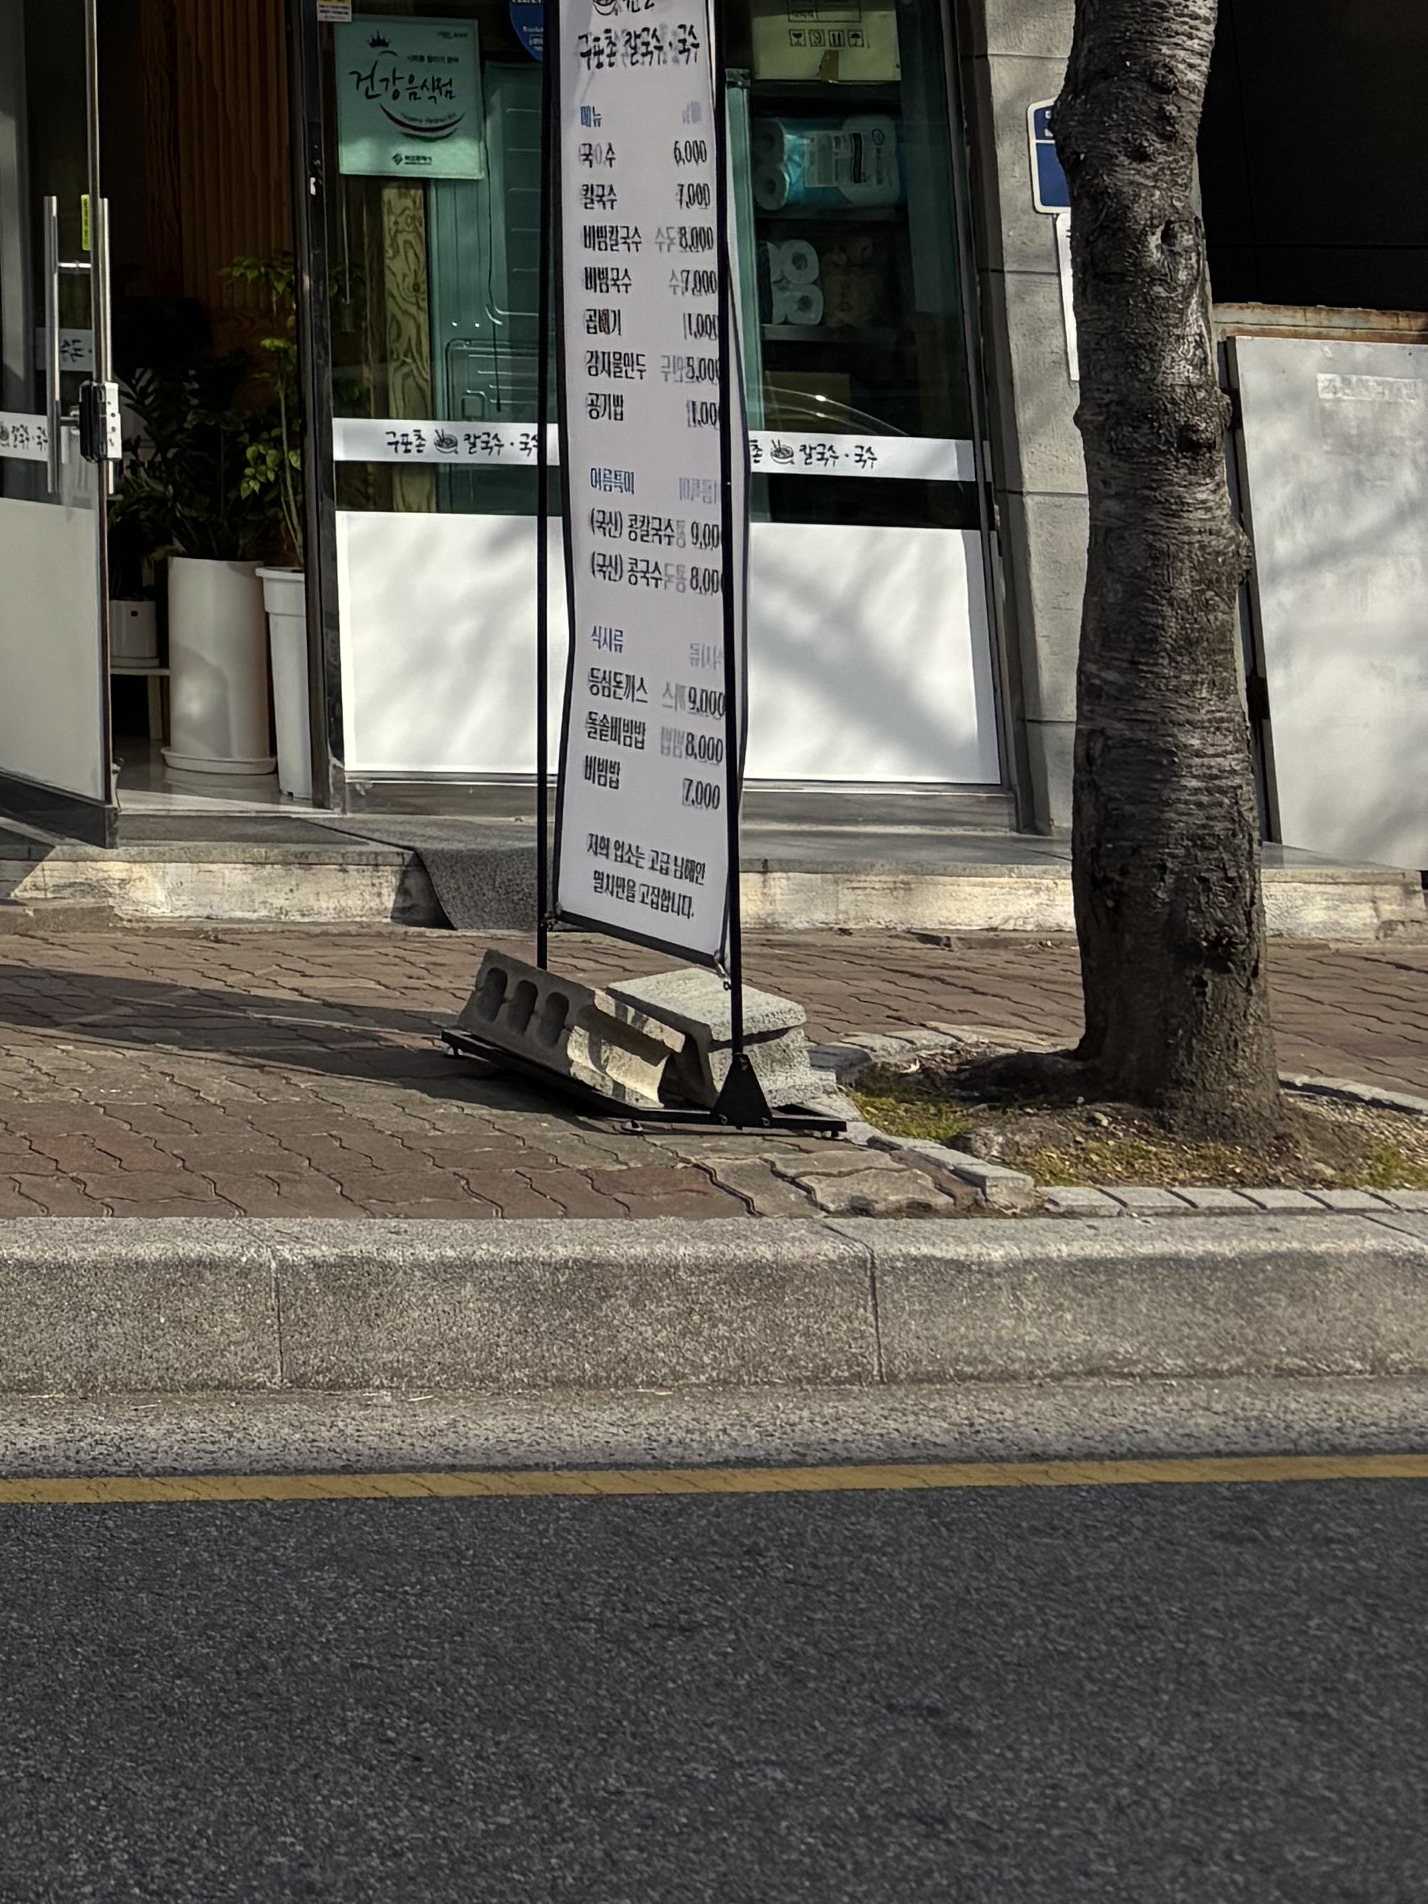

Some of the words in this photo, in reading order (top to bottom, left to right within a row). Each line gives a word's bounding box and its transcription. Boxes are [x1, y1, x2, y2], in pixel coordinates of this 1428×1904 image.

[577, 28, 617, 71] 구포촌
[623, 26, 664, 67] 칼국수
[677, 23, 700, 65] 국수
[349, 60, 456, 105] 건강음식점
[581, 183, 618, 210] 칼국수
[583, 224, 643, 252] 비빔칼국수
[584, 266, 632, 294] 비빔국수
[585, 350, 647, 381] 감자물만두
[586, 392, 624, 422] 공기밥
[385, 429, 427, 454] 구포촌
[463, 432, 505, 456] 칼국수
[799, 443, 840, 467] 칼국수
[854, 445, 878, 469] 국수
[590, 507, 623, 539] (국산)
[627, 513, 675, 547] 콩칼국수
[591, 551, 624, 583] (국산)
[628, 557, 664, 589] 콩국수
[591, 625, 624, 654] 식사류
[589, 667, 648, 703] 등심돈까스
[587, 711, 647, 750] 돌솥비빔밥
[584, 755, 621, 790] 비빔밥
[587, 832, 611, 860] 저희
[613, 839, 646, 870] 업소는
[649, 849, 670, 876] 고급
[673, 855, 706, 886] 남해안
[593, 869, 636, 903] 멸치만을
